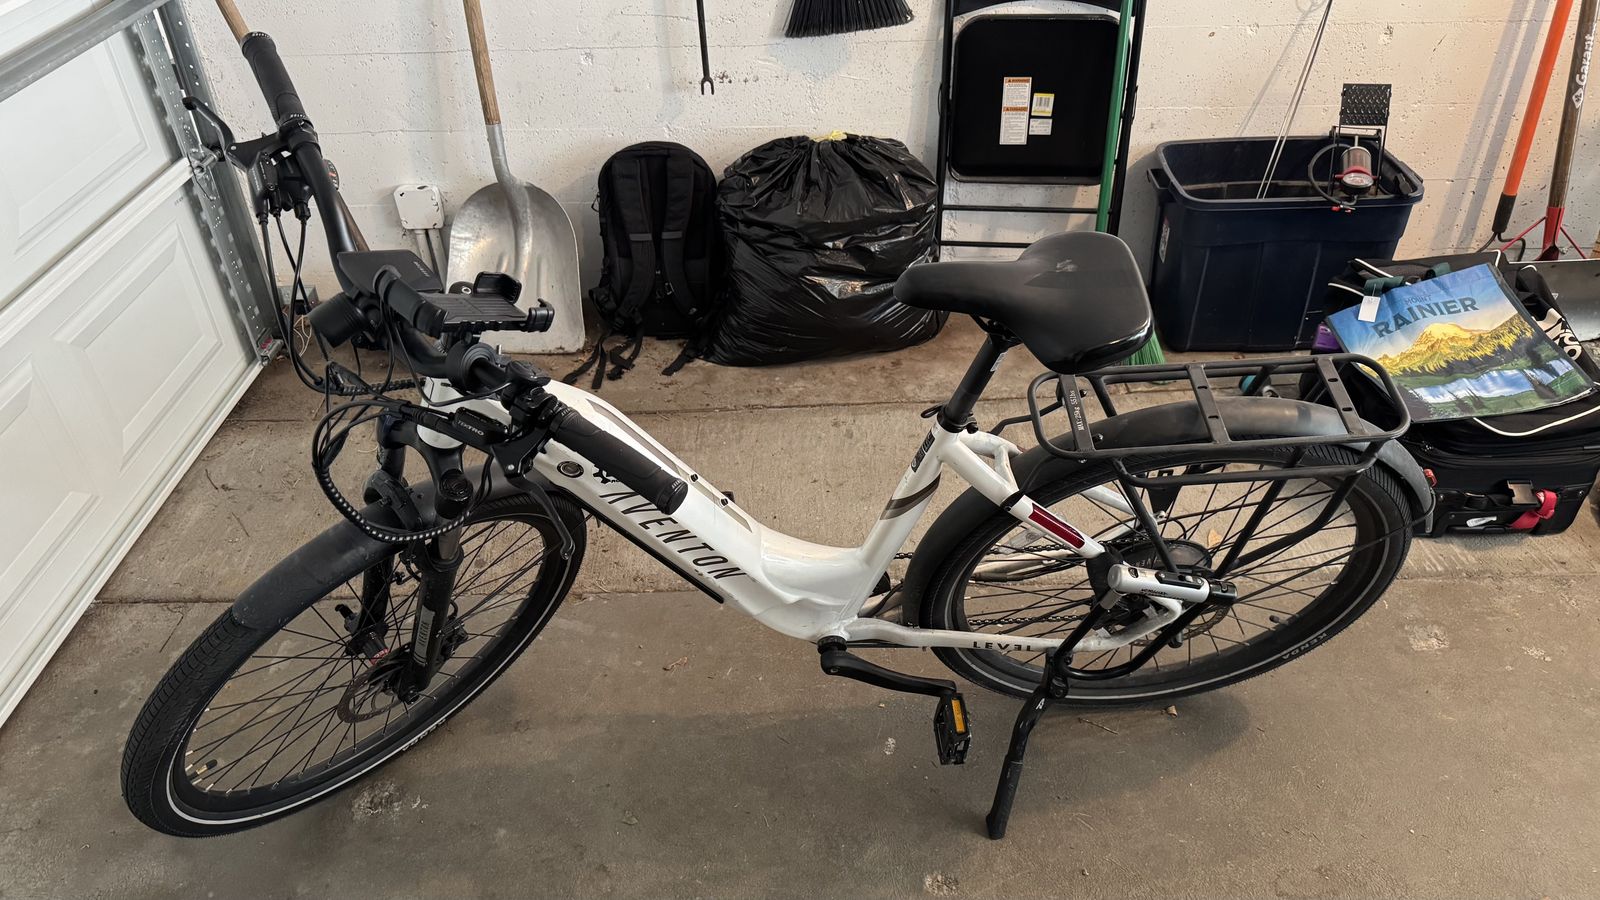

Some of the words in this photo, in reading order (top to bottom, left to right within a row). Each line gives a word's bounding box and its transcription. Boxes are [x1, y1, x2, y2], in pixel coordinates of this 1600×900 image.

[1372, 297, 1480, 338] RAINIER
[598, 491, 747, 580] AVENTON
[1282, 632, 1328, 660] KENDA
